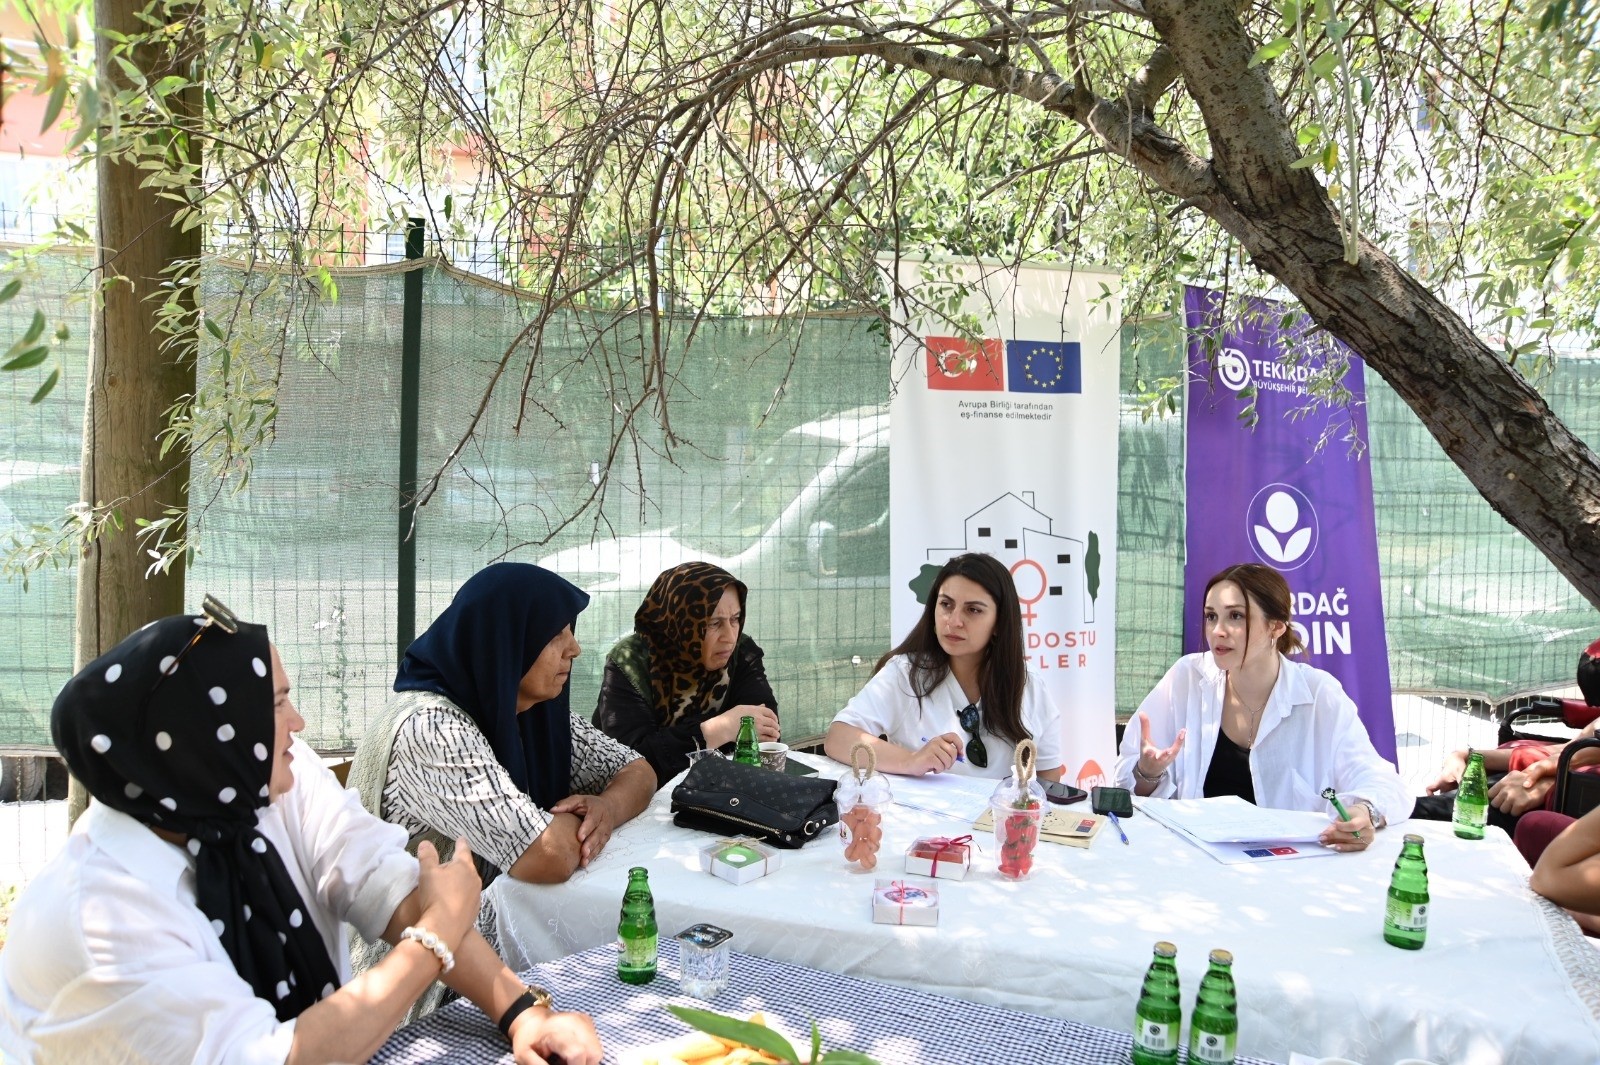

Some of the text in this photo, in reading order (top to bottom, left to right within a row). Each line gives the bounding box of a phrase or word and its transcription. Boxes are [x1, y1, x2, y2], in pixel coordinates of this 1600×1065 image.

[1254, 380, 1296, 394] BÜYÜKŞEHİR
[959, 400, 1054, 411] Avrupa Birliği tarafından
[960, 410, 1052, 420] eş-finanse edilmektedir
[1290, 587, 1349, 616] RDAĞ
[1027, 630, 1096, 649] DOSTU
[1288, 621, 1352, 655] DIN
[1023, 654, 1086, 669] LER
